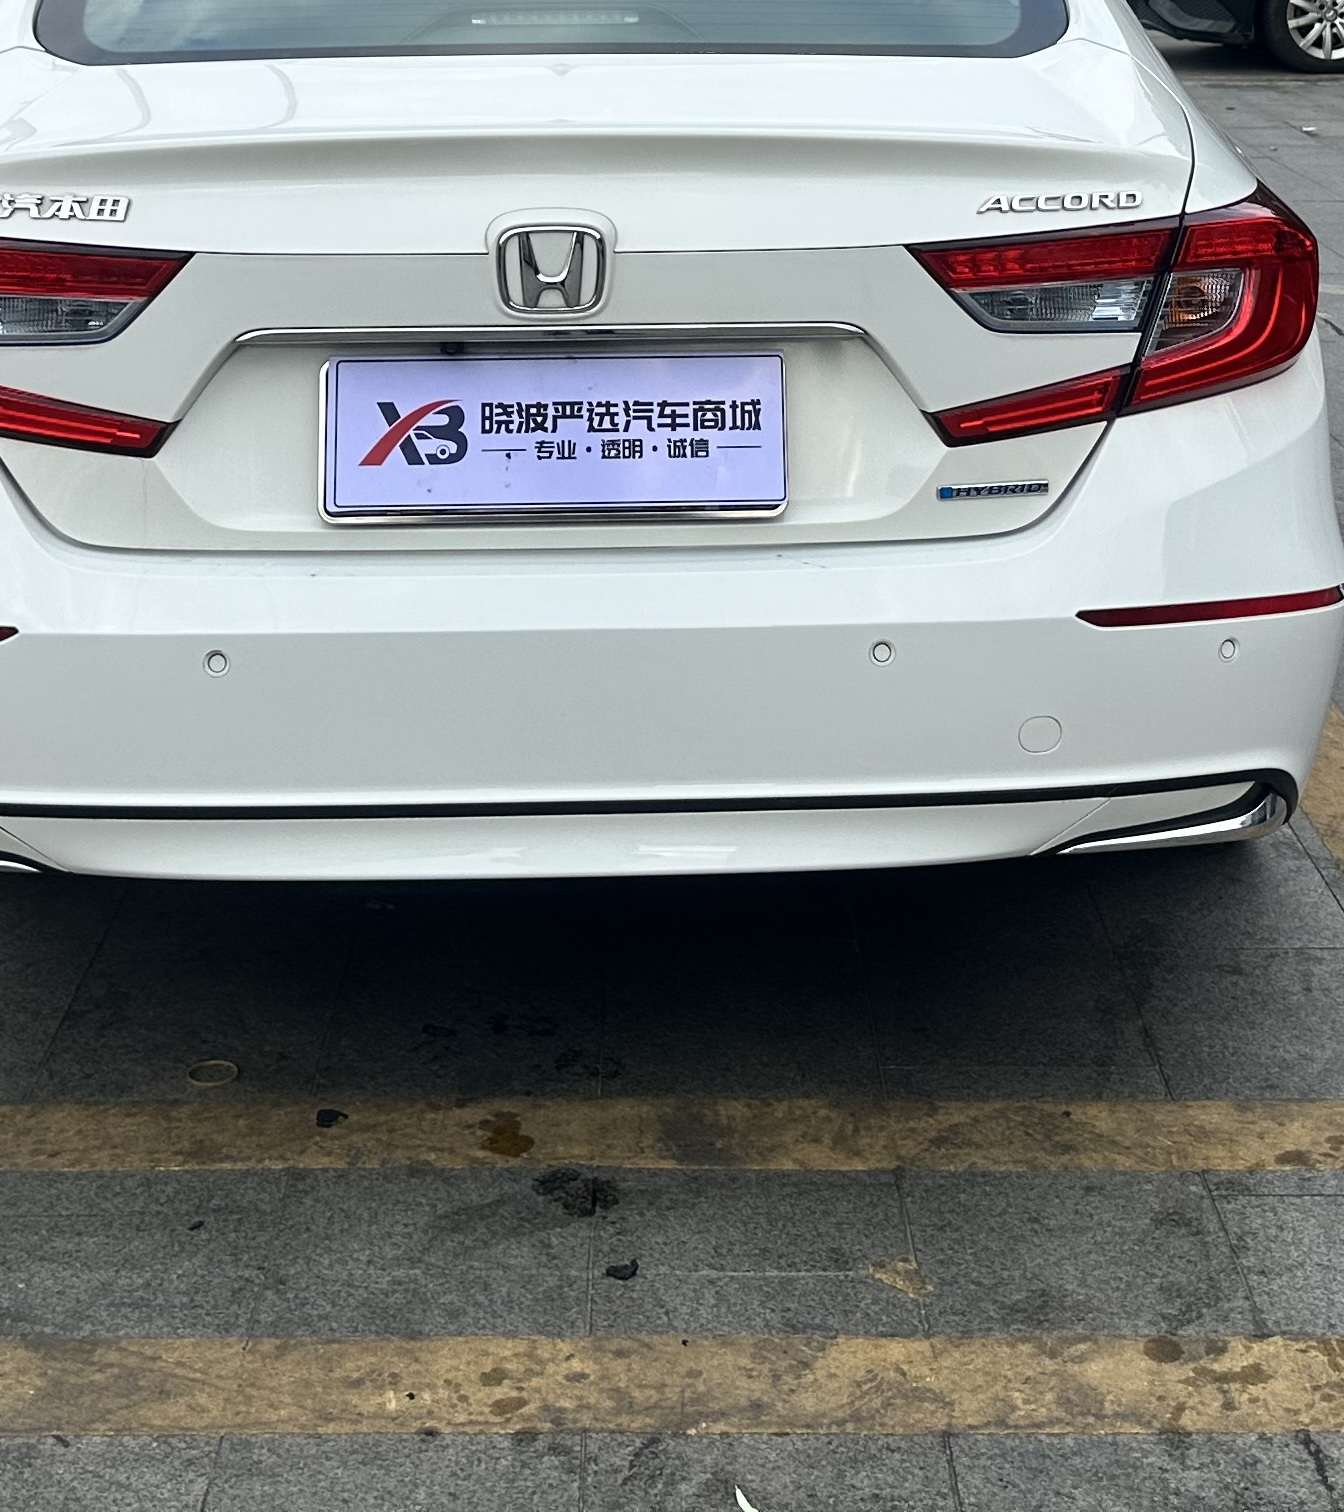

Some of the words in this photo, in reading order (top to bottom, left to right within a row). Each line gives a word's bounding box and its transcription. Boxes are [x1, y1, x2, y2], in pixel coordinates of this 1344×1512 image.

[976, 190, 1144, 215] ACCORD
[480, 399, 762, 435] 晓波严选汽车商城
[955, 482, 1043, 498] HYBRID
